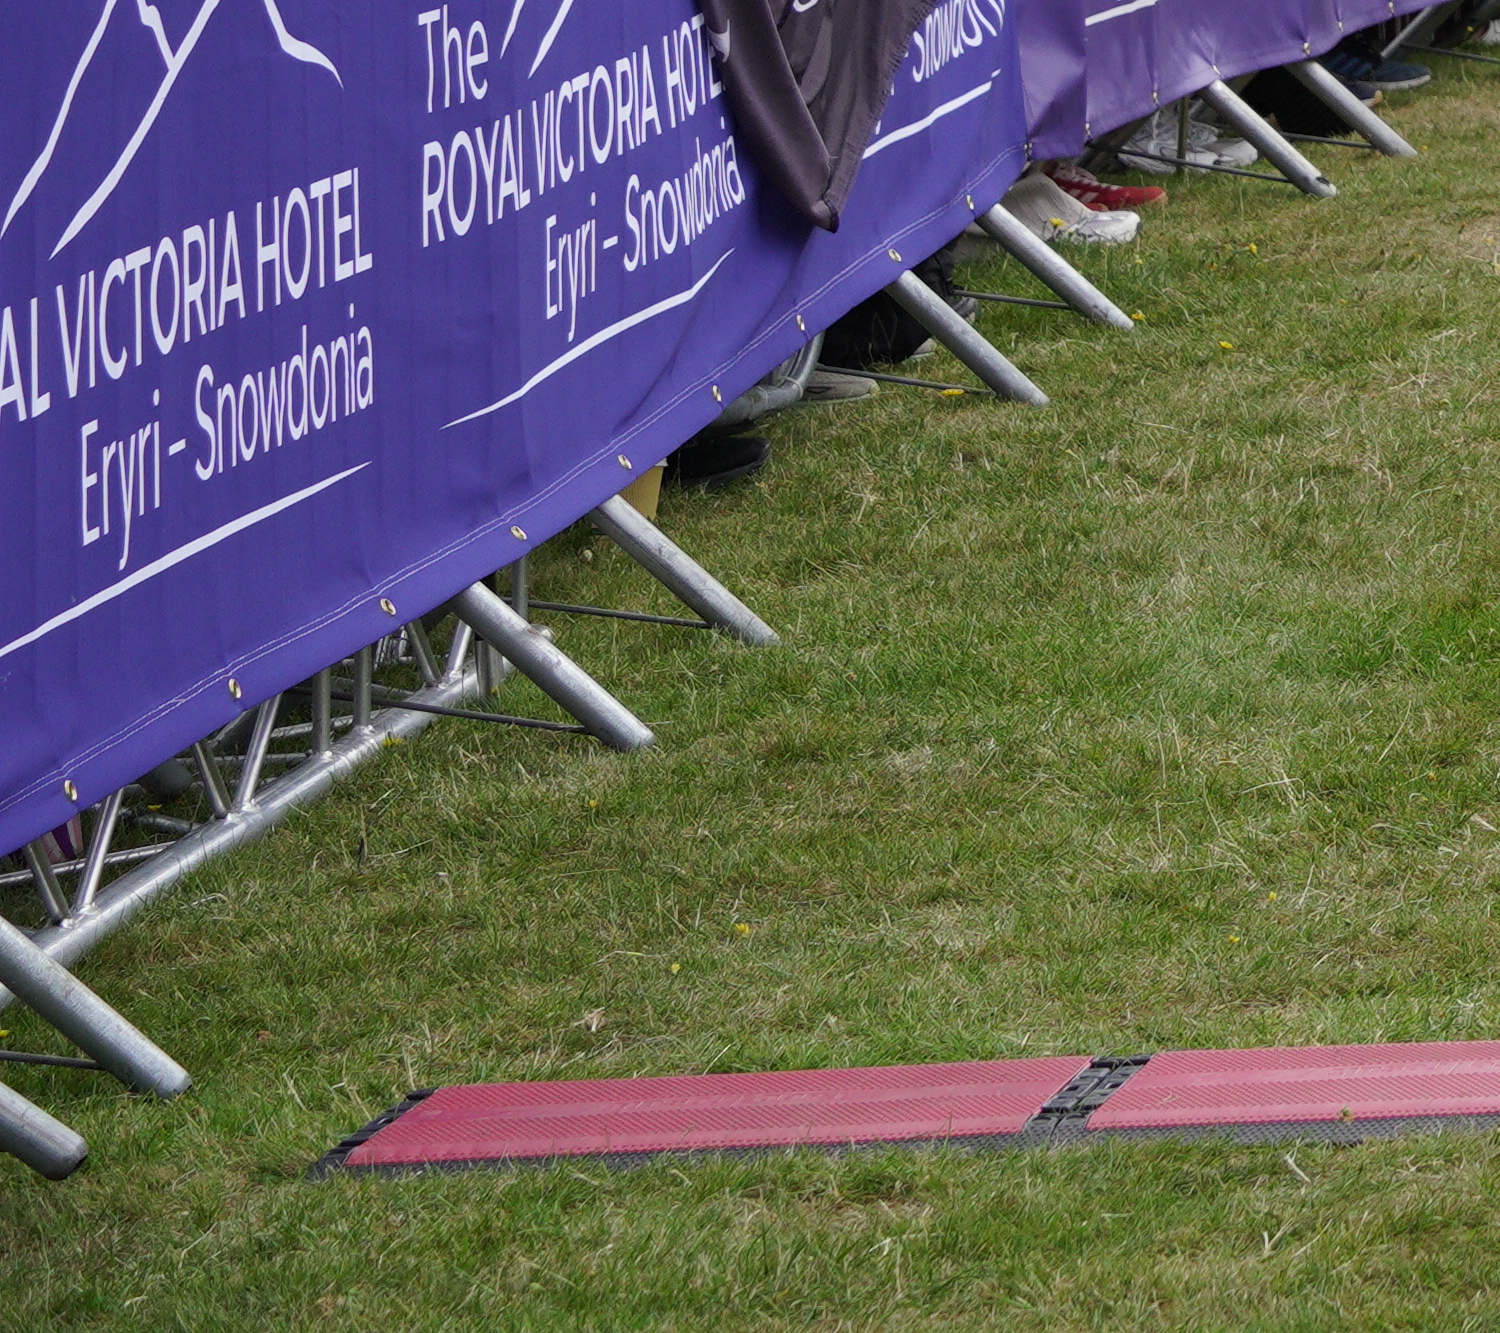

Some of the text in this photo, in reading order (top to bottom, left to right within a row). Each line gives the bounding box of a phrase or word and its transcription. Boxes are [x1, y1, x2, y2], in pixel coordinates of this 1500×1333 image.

[417, 5, 488, 116] The
[420, 113, 531, 250] ROYAL
[530, 43, 661, 196] VICTORIA
[58, 206, 246, 395] VICTORIA
[255, 167, 374, 315] HOTEL
[544, 123, 745, 343] Eryri Snowdonia
[80, 403, 162, 571] Eryri
[195, 303, 375, 482] Snowdonia
